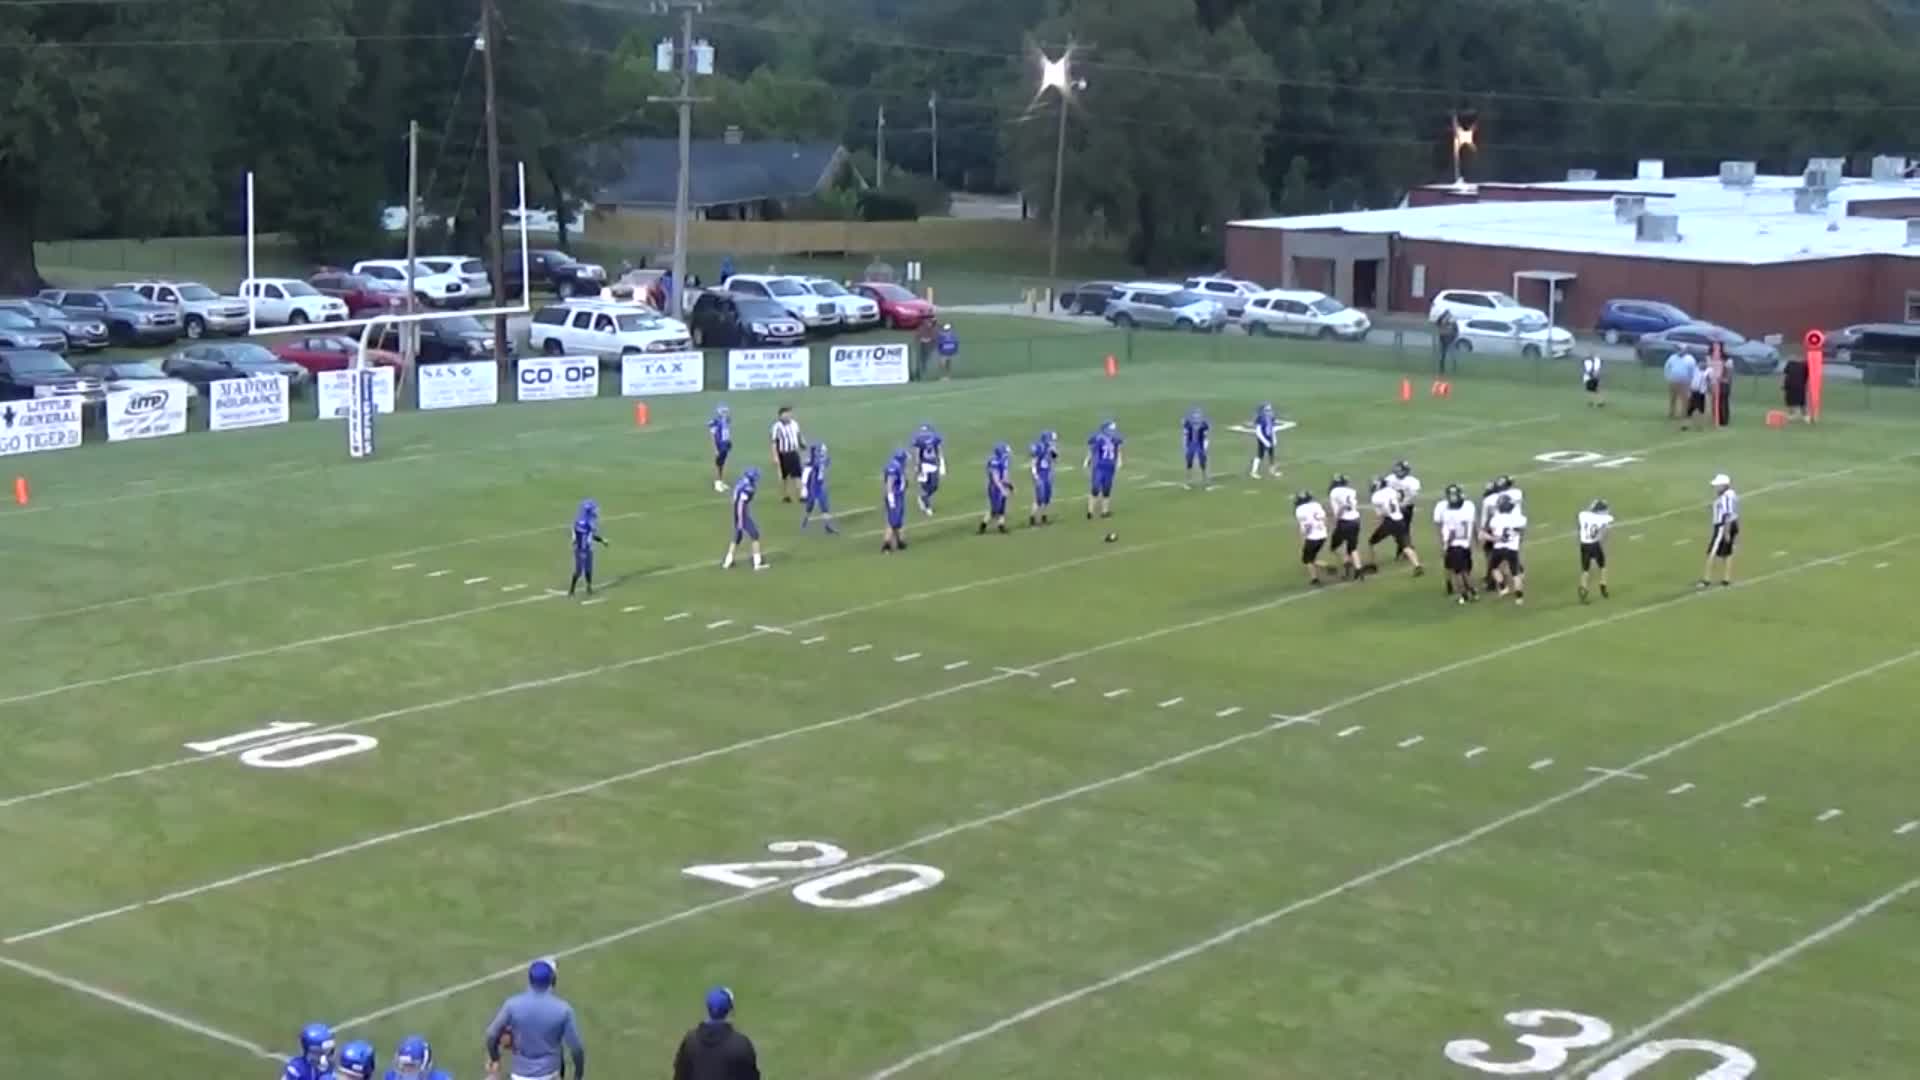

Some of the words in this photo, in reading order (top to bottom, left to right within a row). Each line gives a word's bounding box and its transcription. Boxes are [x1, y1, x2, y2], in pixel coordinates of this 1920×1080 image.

[183, 721, 379, 768] 10
[681, 840, 945, 908] 20
[1443, 1009, 1757, 1080] 30
